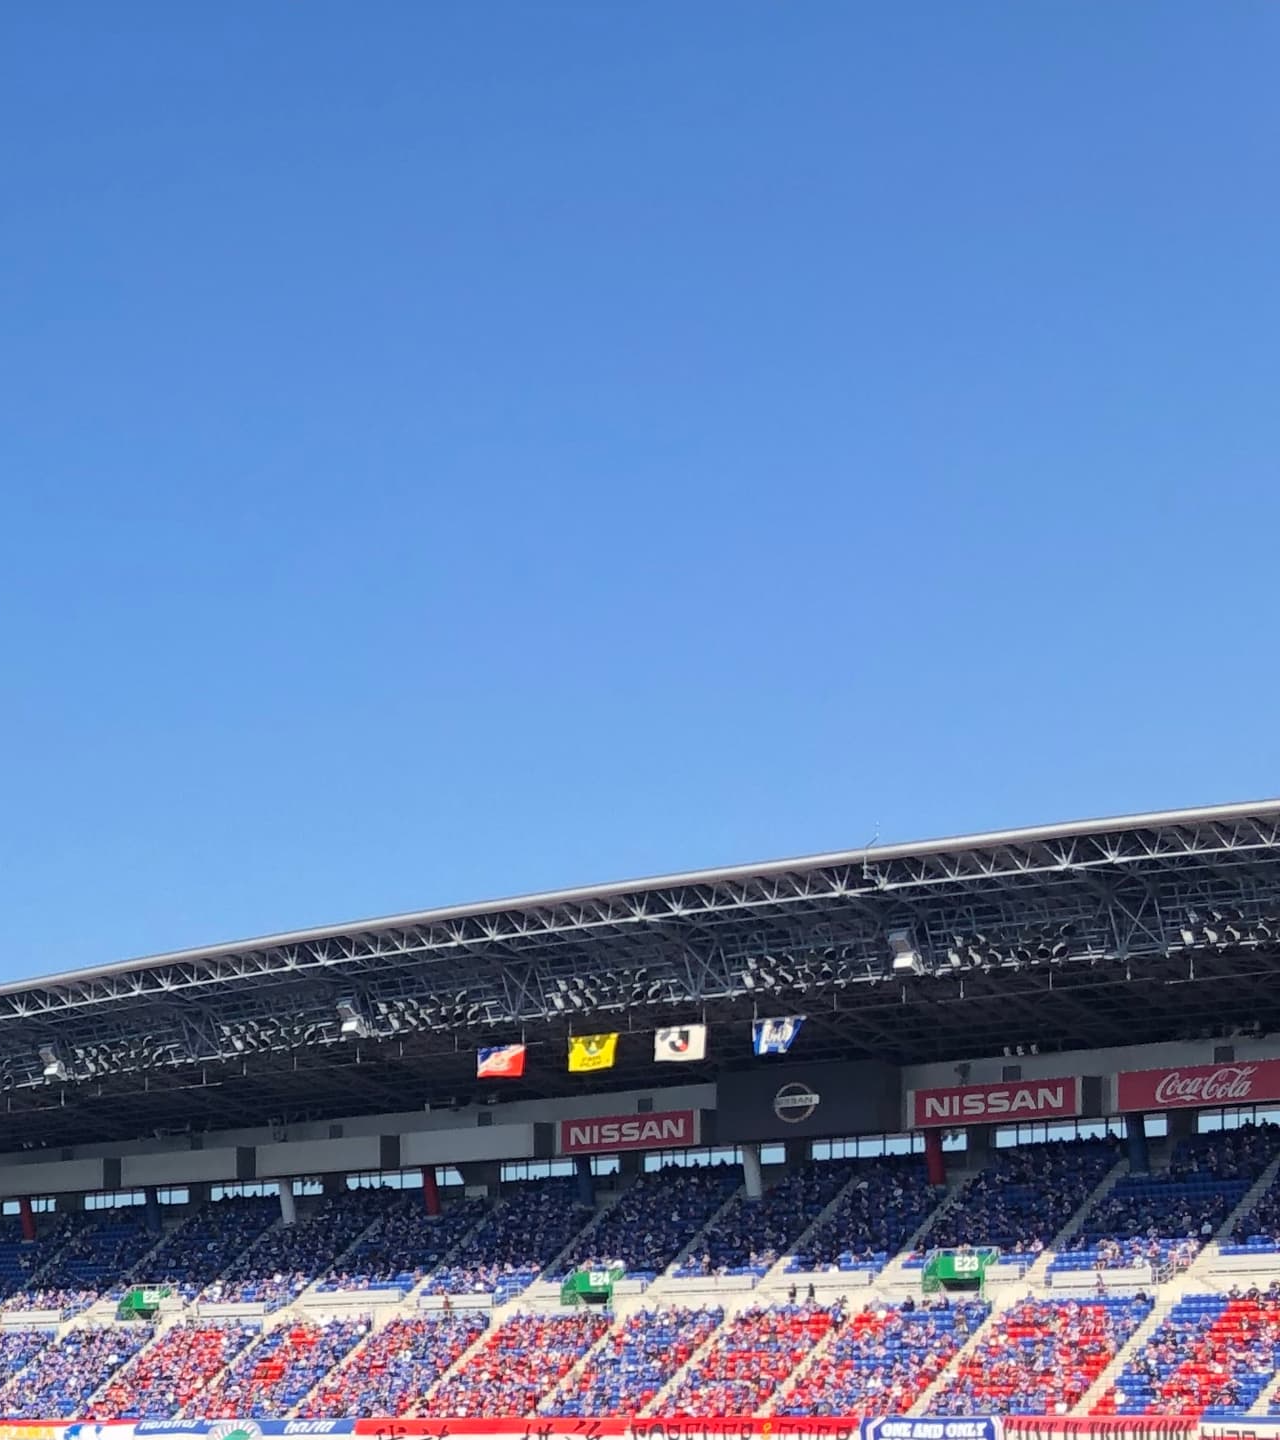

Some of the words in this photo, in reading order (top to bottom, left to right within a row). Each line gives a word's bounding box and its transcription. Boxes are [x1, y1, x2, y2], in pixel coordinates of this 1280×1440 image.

[925, 1087, 1065, 1118] NISSAN
[570, 1118, 685, 1146] NISSAN
[954, 1256, 979, 1272] E23
[881, 1423, 911, 1438] ONE
[913, 1423, 943, 1438] AND
[945, 1422, 986, 1438] ONLY
